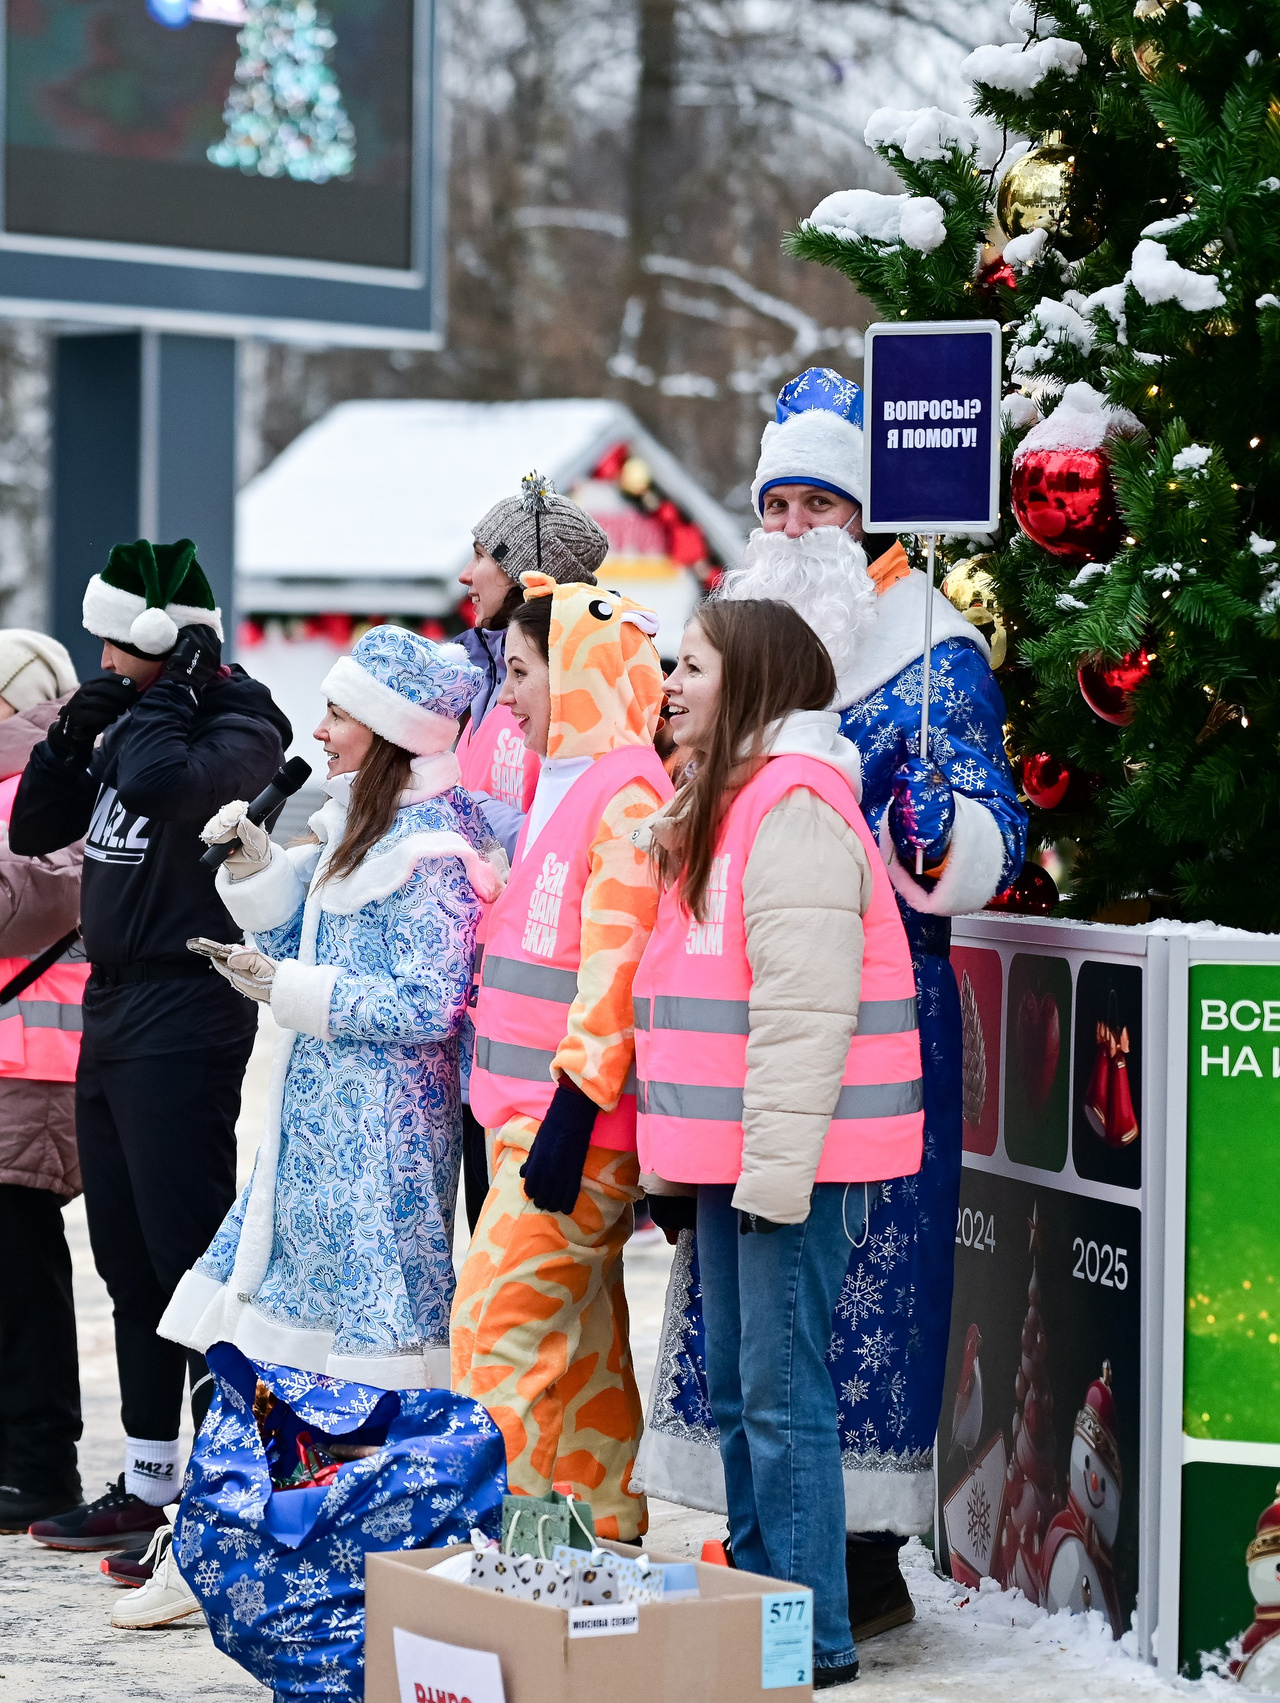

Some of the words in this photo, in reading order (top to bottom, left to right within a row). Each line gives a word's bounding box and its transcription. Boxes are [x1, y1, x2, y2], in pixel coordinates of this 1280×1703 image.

[883, 398, 982, 421] ВОПРОСЫ?
[887, 429, 899, 449] Я
[902, 427, 978, 449] ПОМОГУ!
[536, 852, 569, 898] Sat
[707, 853, 731, 891] at
[528, 889, 562, 928] 9AM
[521, 919, 557, 958] 5KM
[685, 922, 724, 956] 5KM
[1201, 1045, 1264, 1078] НА
[1072, 1237, 1128, 1290] 2025
[770, 1601, 805, 1624] 577
[797, 1669, 805, 1682] 2
